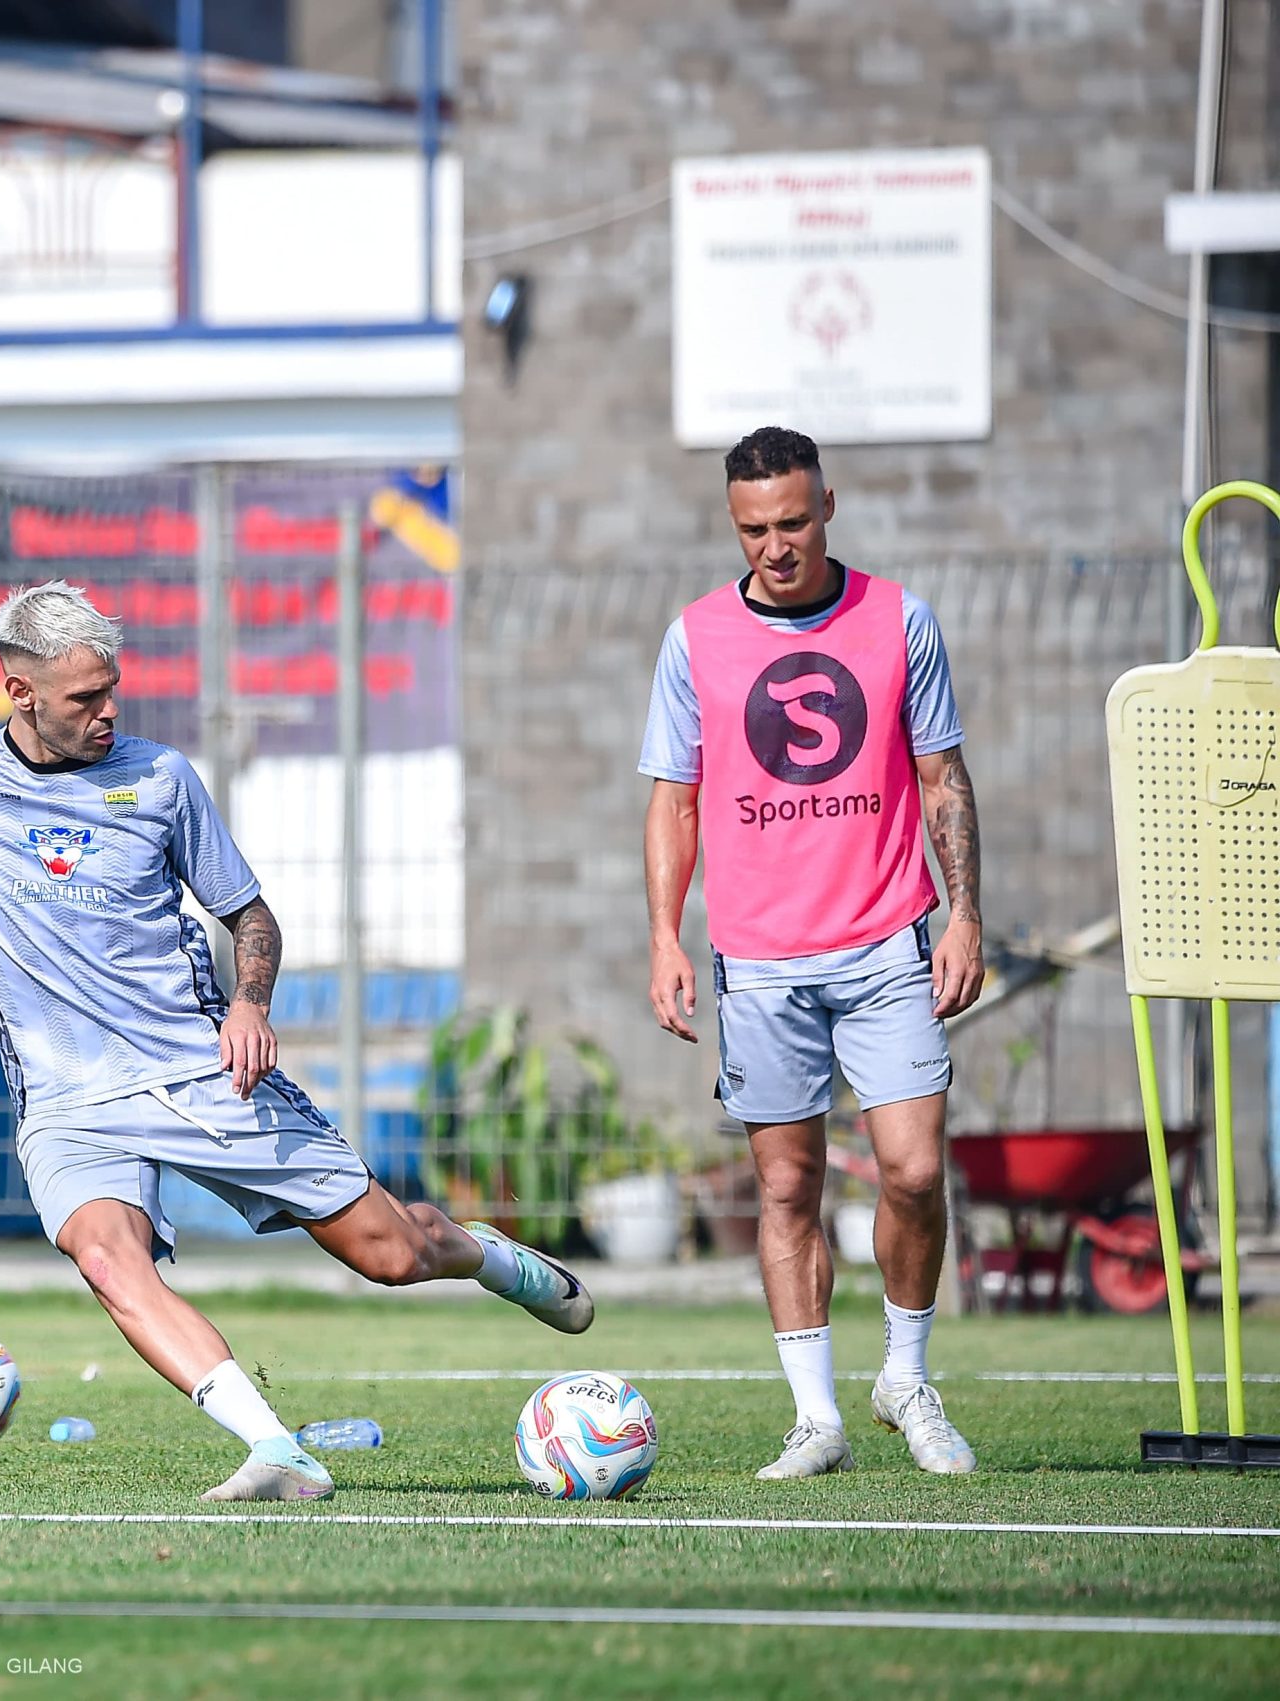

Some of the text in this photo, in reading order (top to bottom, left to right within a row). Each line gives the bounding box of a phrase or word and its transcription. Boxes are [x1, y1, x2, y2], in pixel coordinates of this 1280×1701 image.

[735, 792, 881, 831] Sportama
[11, 878, 110, 904] PANTHER
[566, 1385, 618, 1404] SPECS
